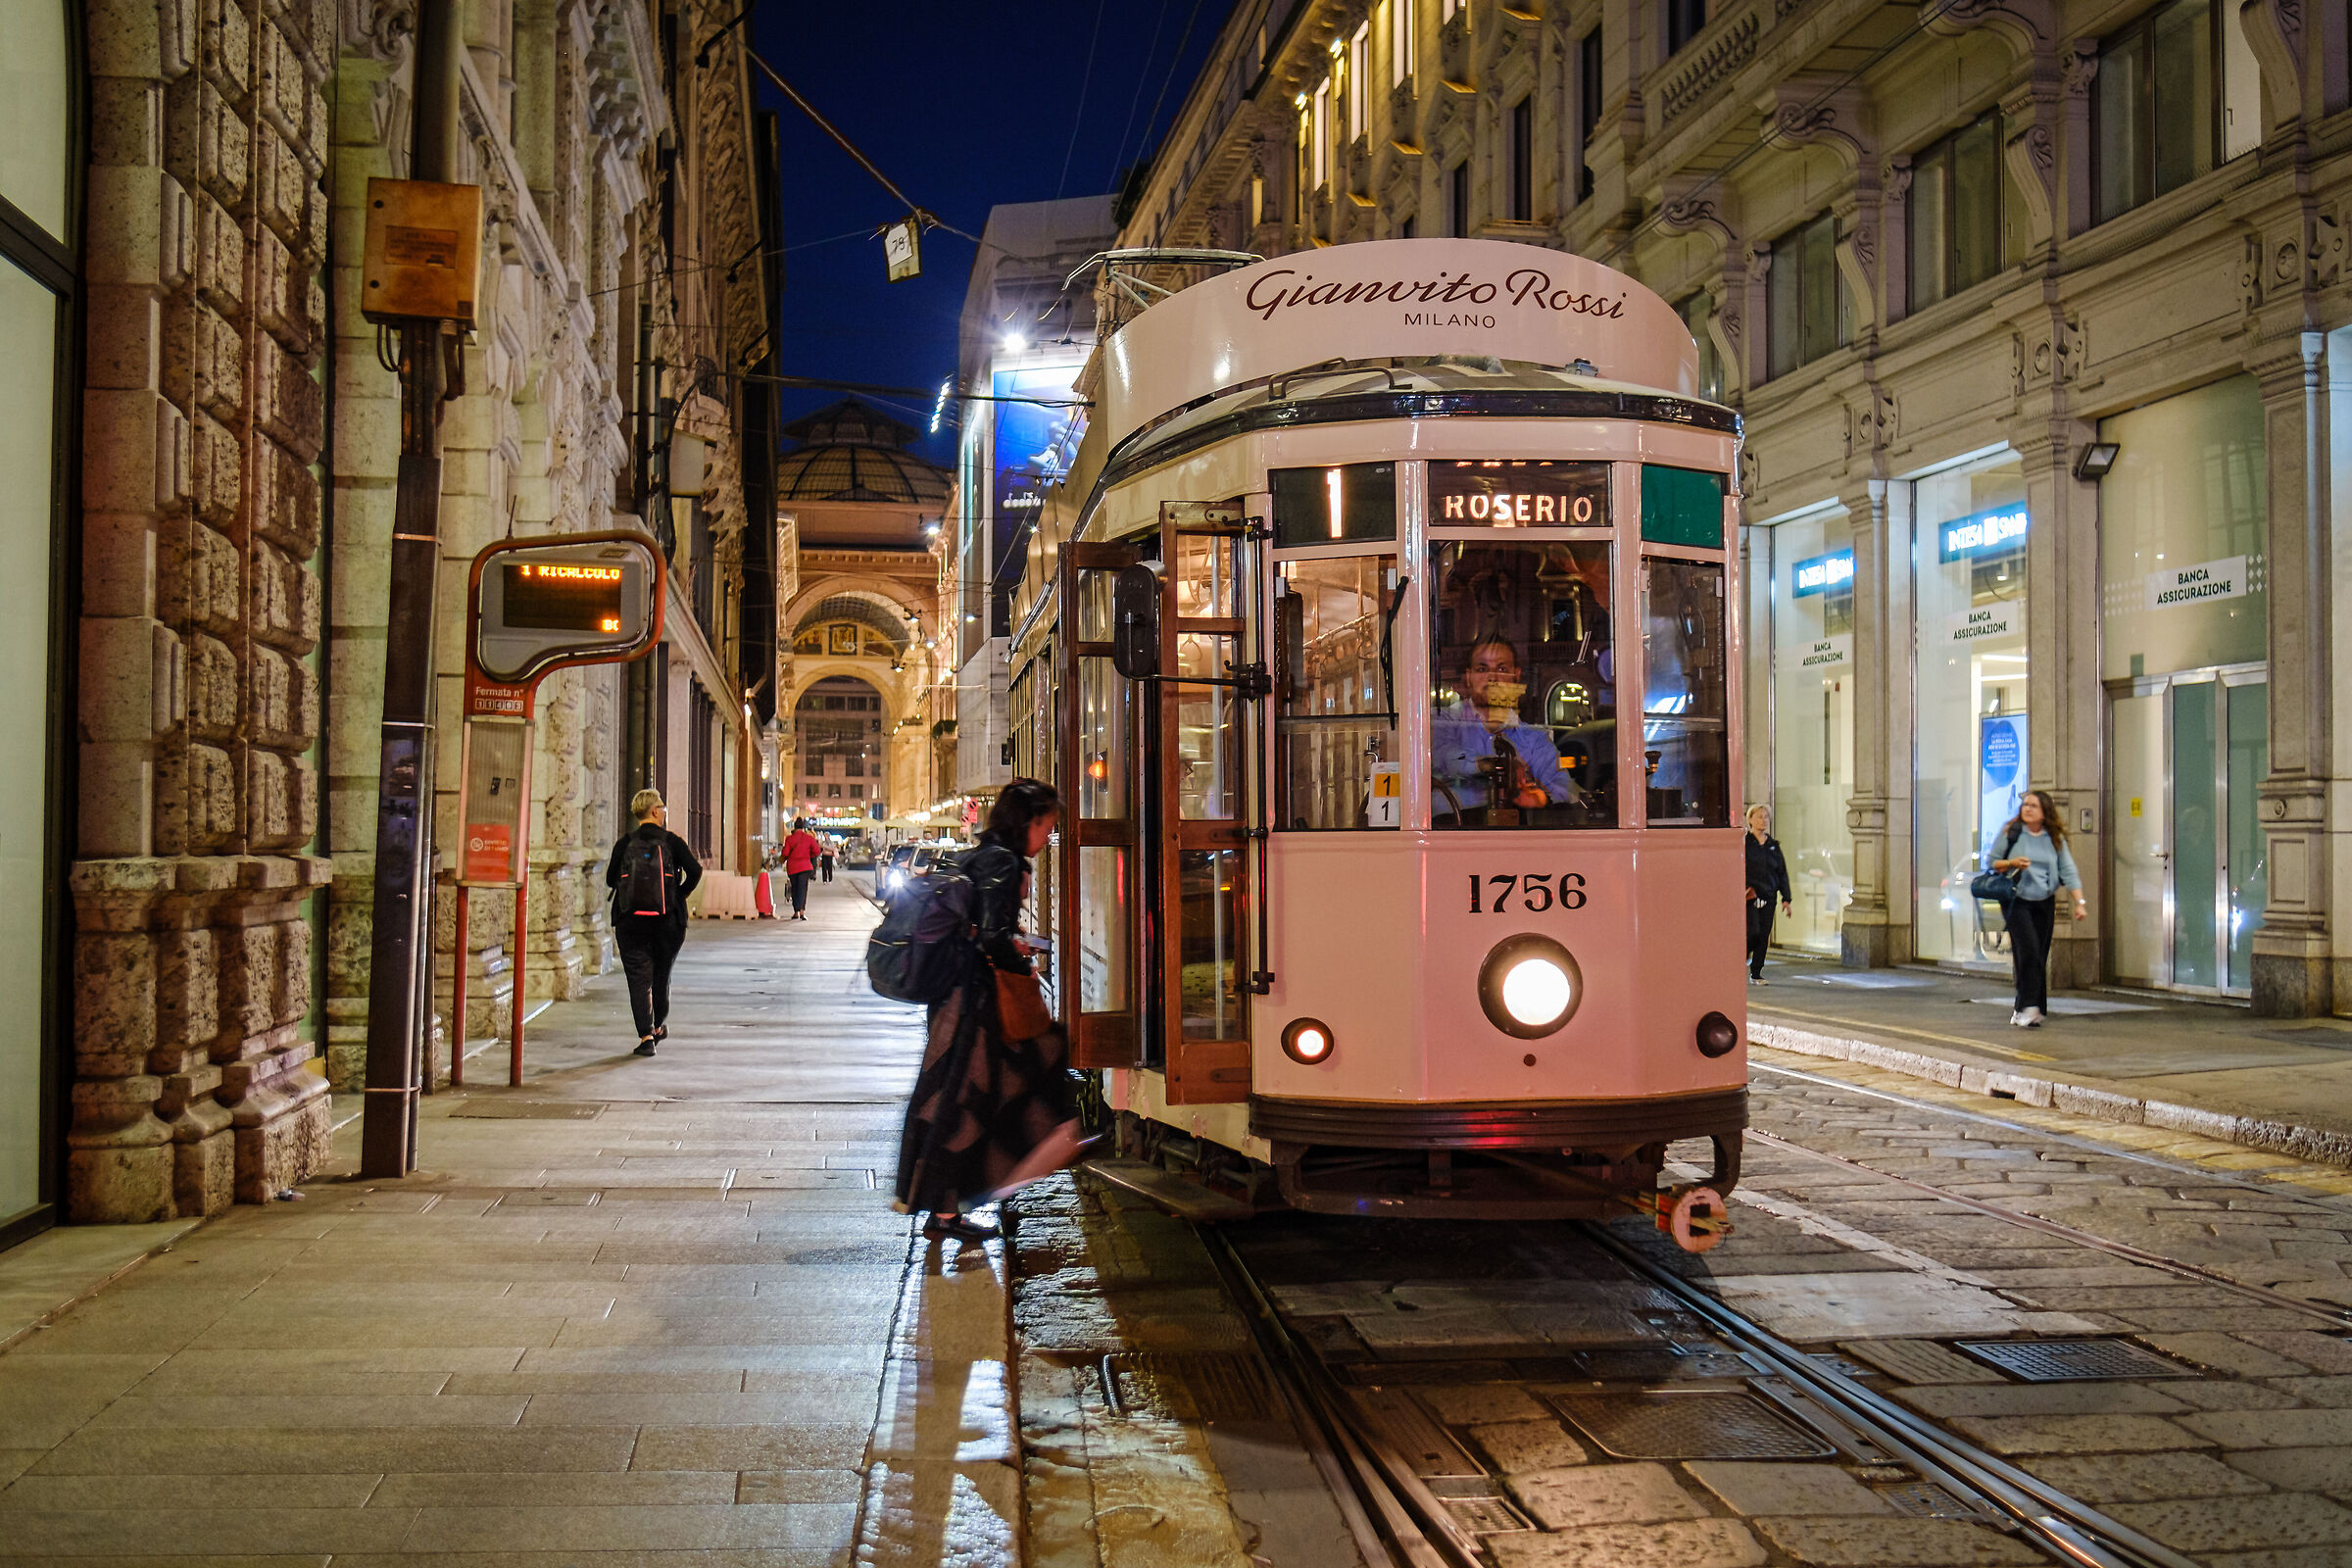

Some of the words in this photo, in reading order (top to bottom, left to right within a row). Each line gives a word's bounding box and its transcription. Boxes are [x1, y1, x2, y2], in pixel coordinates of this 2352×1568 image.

[1246, 270, 1497, 321] Gianvito
[1505, 269, 1628, 319] Rossi
[1404, 313, 1495, 329] MILANO
[1327, 468, 1343, 538] 1
[1445, 494, 1592, 522] ROSERIO
[2178, 568, 2210, 585] BANCA
[2157, 580, 2231, 605] ASSICURAZIONE
[1968, 611, 1991, 624] BANCA
[1953, 620, 2007, 640] ASSICURAZIONE
[1814, 642, 1832, 653] BANCA
[1802, 651, 1843, 666] ASSICURAZIONE
[475, 686, 512, 697] Fermata
[1383, 775, 1392, 796] 1
[1381, 800, 1390, 821] 1
[1469, 873, 1588, 912] 1756
